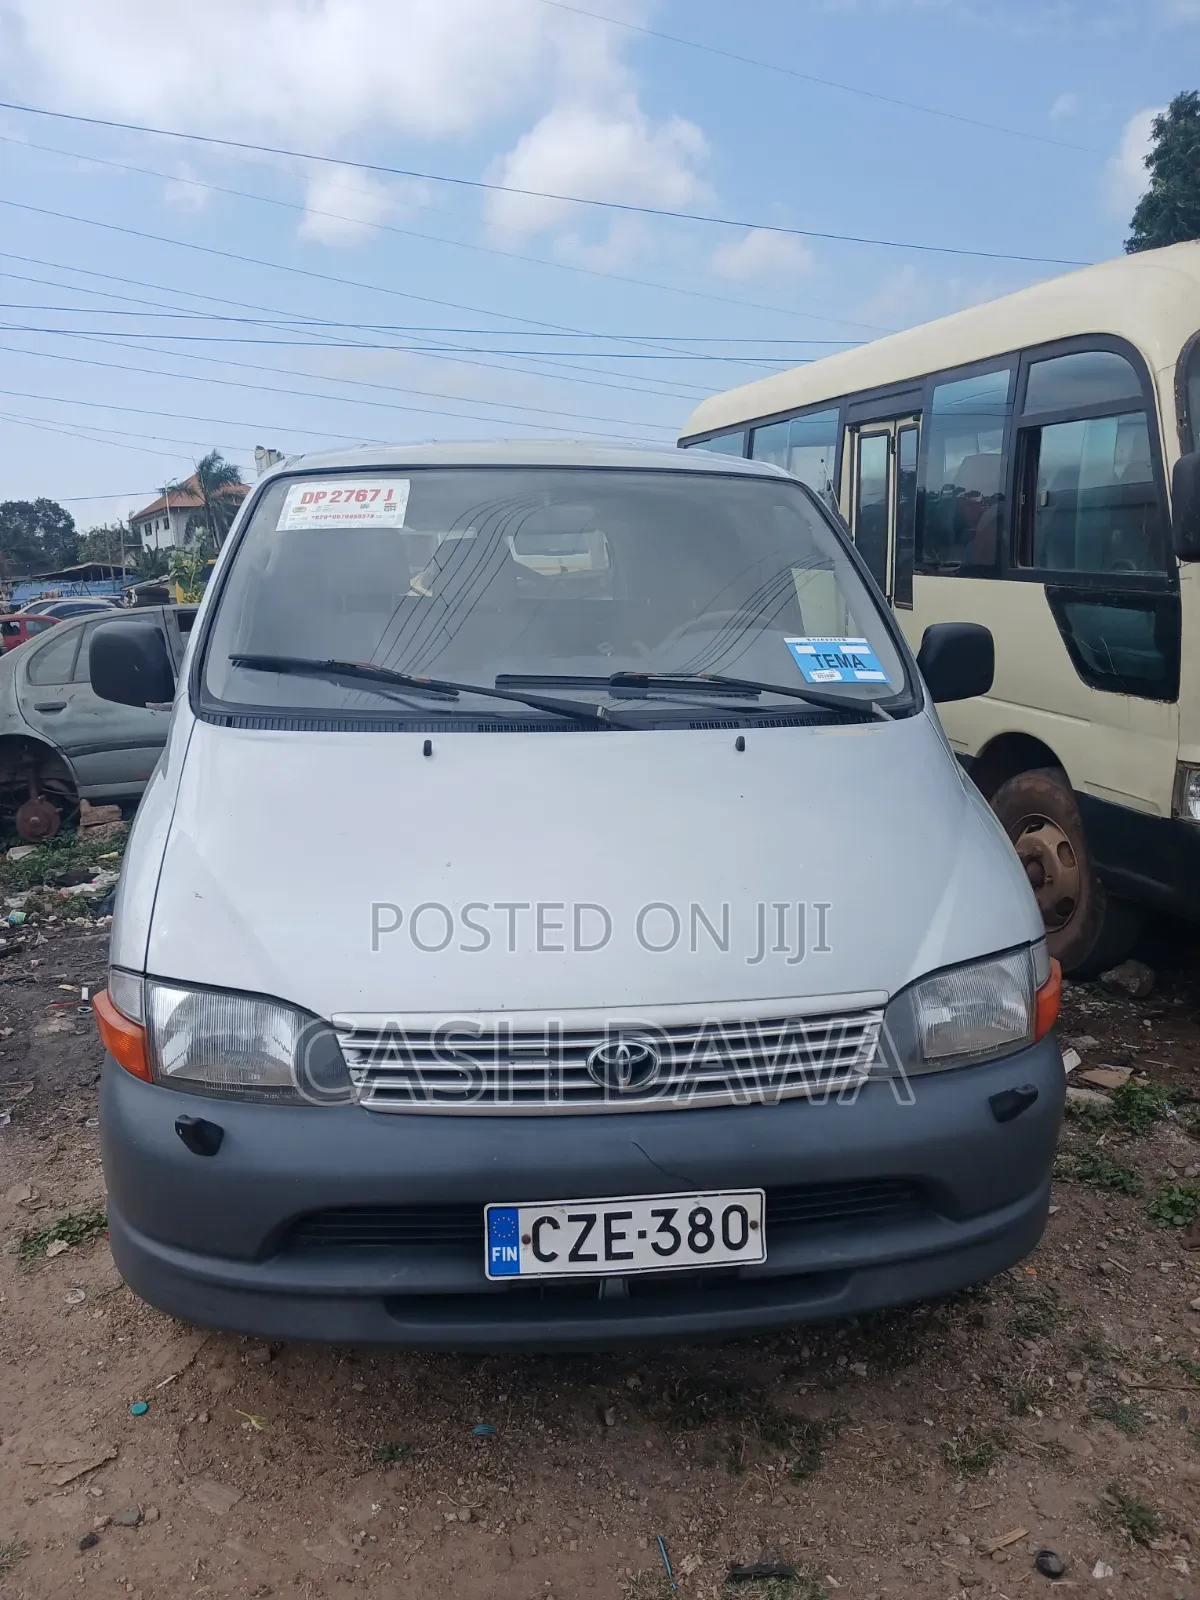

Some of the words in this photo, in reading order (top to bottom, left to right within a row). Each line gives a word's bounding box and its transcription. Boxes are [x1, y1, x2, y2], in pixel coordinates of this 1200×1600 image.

[301, 491, 327, 505] DP
[329, 489, 381, 503] 2767
[384, 489, 394, 502] J
[811, 653, 867, 669] TEMA
[531, 1203, 749, 1263] CZE-380
[492, 1246, 517, 1262] FIN
